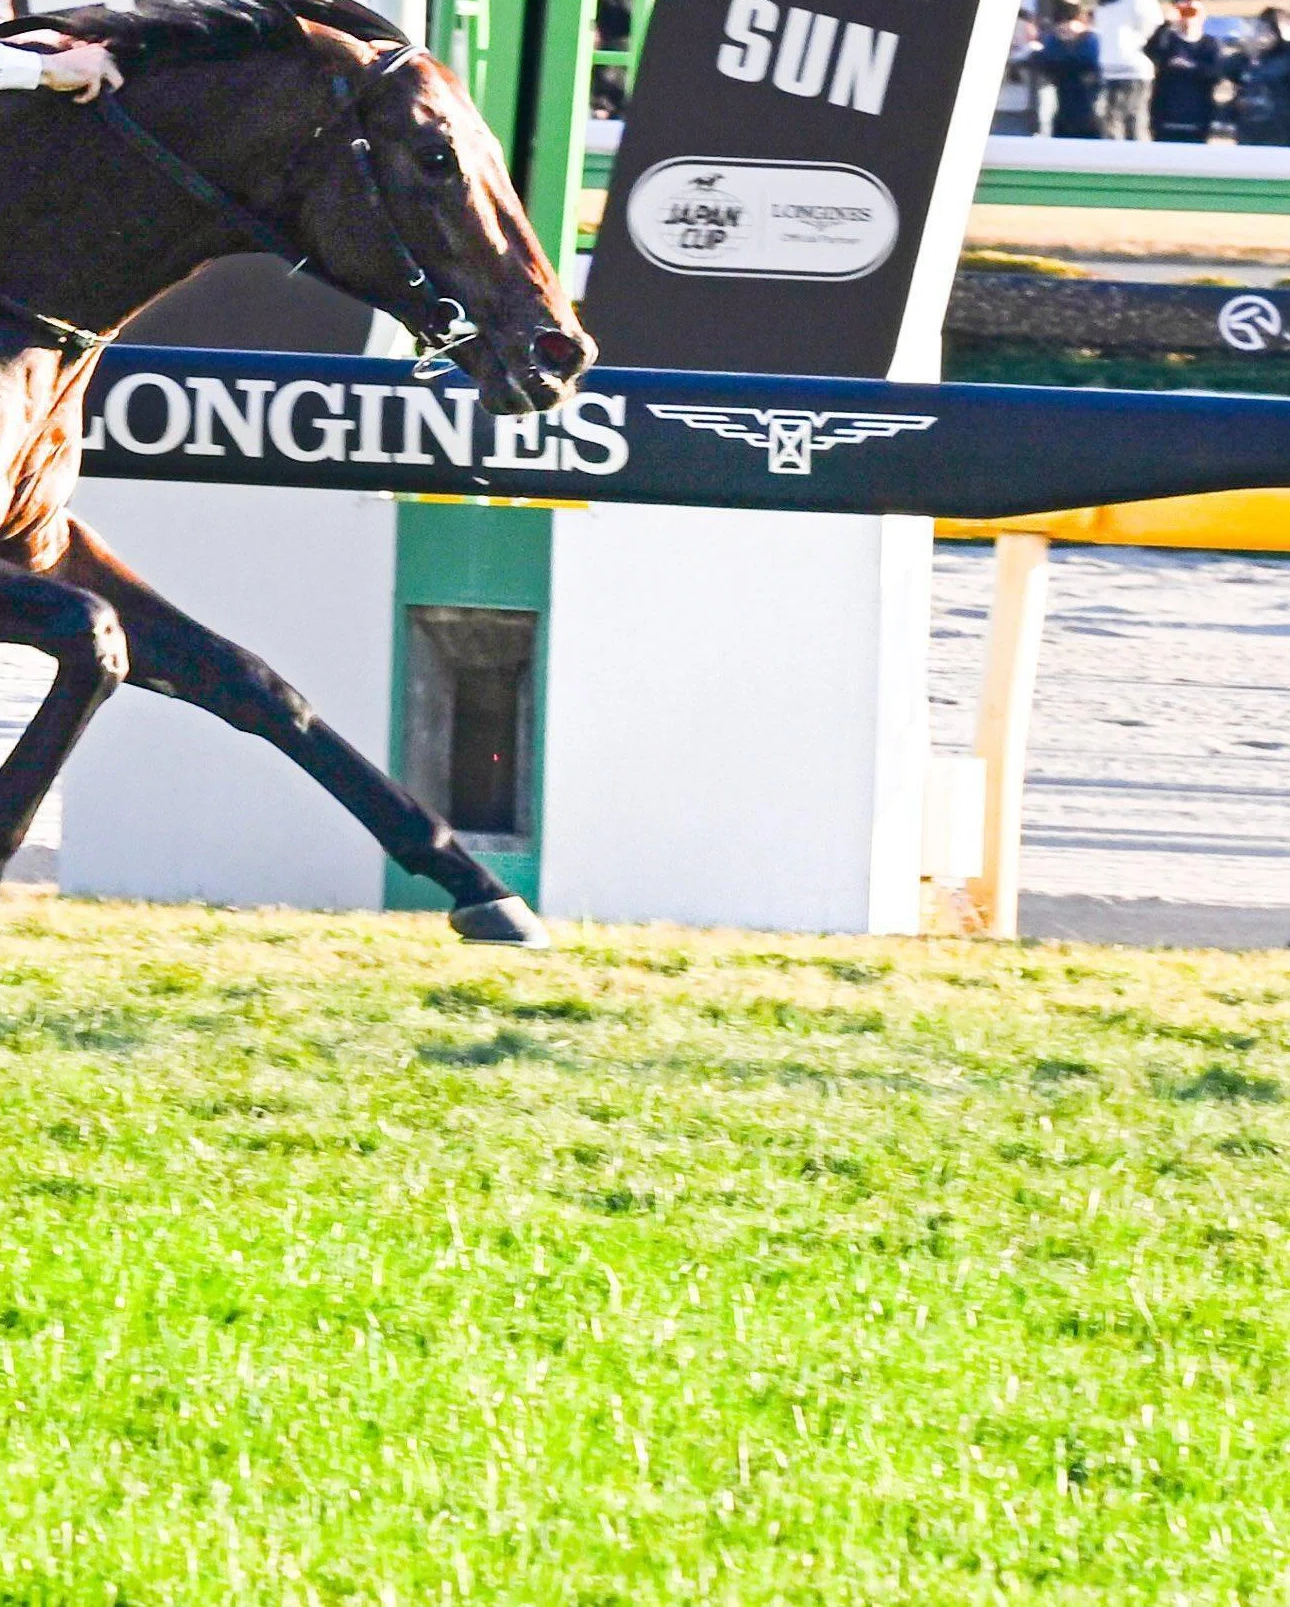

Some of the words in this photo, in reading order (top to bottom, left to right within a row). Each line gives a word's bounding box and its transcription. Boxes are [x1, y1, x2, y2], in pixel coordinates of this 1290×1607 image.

[664, 203, 744, 227] JAPAN
[771, 204, 872, 222] LONGINES
[678, 228, 728, 250] CUP
